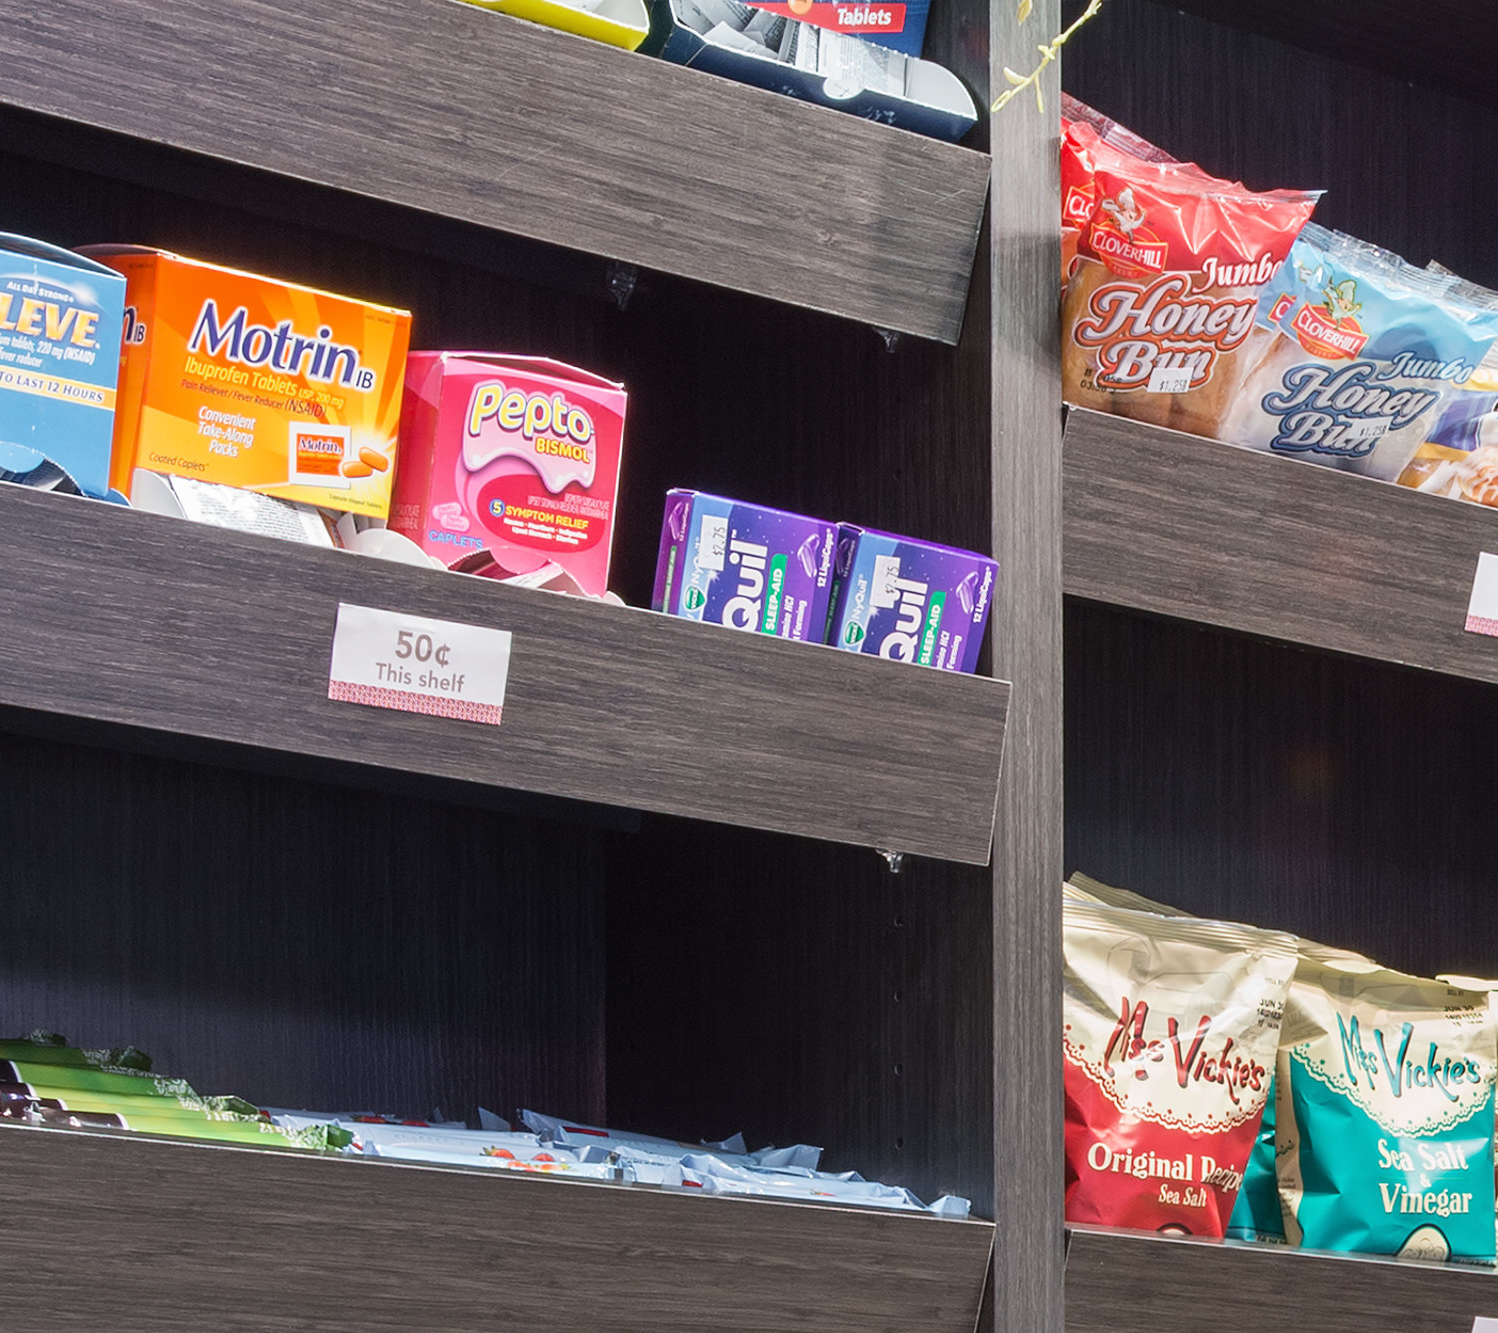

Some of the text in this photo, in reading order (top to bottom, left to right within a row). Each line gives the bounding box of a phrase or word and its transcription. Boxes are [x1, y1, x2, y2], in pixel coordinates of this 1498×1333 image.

[838, 8, 892, 26] Tablets
[1092, 230, 1163, 270] CLOVERHILL
[1076, 274, 1258, 350] Honey
[188, 298, 358, 386] Motrin
[1296, 310, 1361, 355] CLOVERHILL
[184, 356, 297, 397] Ibuprofen Tablets
[1377, 352, 1474, 384] Jumbo
[63, 385, 103, 402] HOURS
[469, 383, 592, 442] Pepto
[1264, 363, 1440, 430] Honey
[428, 530, 484, 549] CAPLETS
[395, 629, 451, 668] 50¢
[375, 661, 465, 693] This shelf
[1088, 1141, 1193, 1182] Original
[1378, 1138, 1469, 1172] Sea Salt
[1158, 1183, 1207, 1208] Sea Salt
[1378, 1182, 1472, 1218] Vinegar
